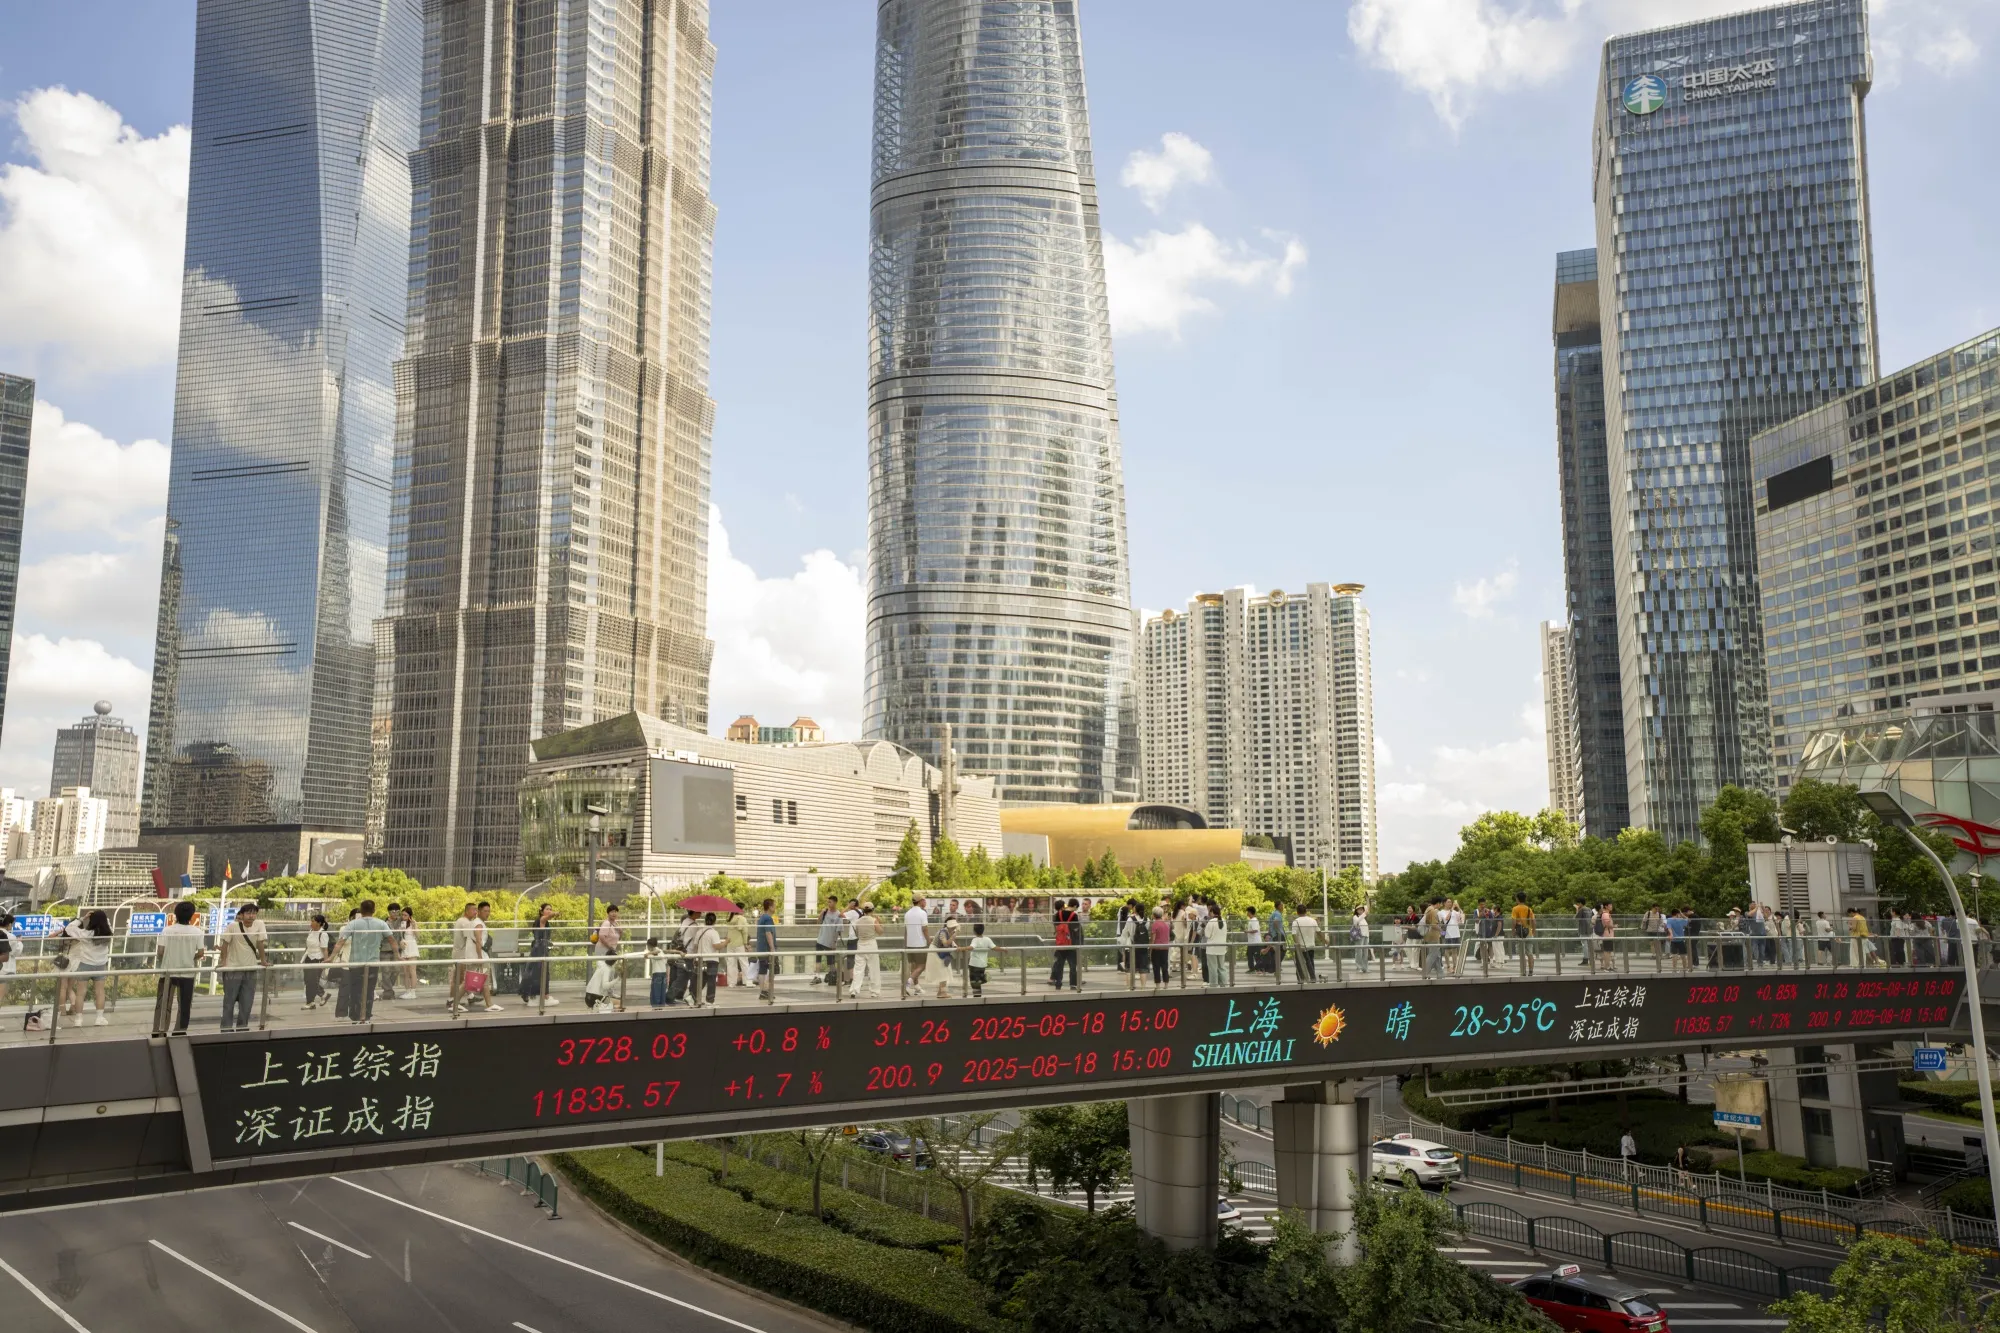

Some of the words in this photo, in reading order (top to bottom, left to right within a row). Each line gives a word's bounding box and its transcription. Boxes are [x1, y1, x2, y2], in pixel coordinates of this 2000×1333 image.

[1683, 59, 1775, 88] 中国太平
[1684, 88, 1721, 101] CHINA
[1727, 78, 1776, 94] TAIPING
[1574, 985, 1647, 1009] 上证综指
[1687, 985, 1741, 1004] 3728.03
[1756, 984, 1799, 1001] +0.85%
[1814, 982, 1849, 999] 31.26
[1856, 981, 1919, 998] 2025-08-18
[1924, 979, 1955, 996] 15:00
[1209, 996, 1284, 1039] 上海
[1385, 1001, 1416, 1041] 晴
[1568, 1016, 1640, 1041] 深证成指
[1674, 1015, 1734, 1035] 11835.57
[1749, 1012, 1792, 1030] +1.73%
[1807, 1010, 1842, 1028] 200.9
[1848, 1007, 1913, 1026] 2025-08-18
[1917, 1006, 1948, 1023] 15:00
[240, 1042, 442, 1089] 上证综指
[557, 1033, 688, 1066] 3728.03
[874, 1020, 951, 1047] 31.26
[970, 1011, 1106, 1041] 2025-08-18
[1119, 1008, 1180, 1032] 15:00
[1192, 1039, 1296, 1068] SHANGHAI
[234, 1095, 434, 1146] 深证成指
[533, 1080, 681, 1117] 11835.57
[866, 1062, 943, 1092] 200.9
[962, 1051, 1098, 1084] 2025-08-18
[1112, 1046, 1172, 1073] 15:00
